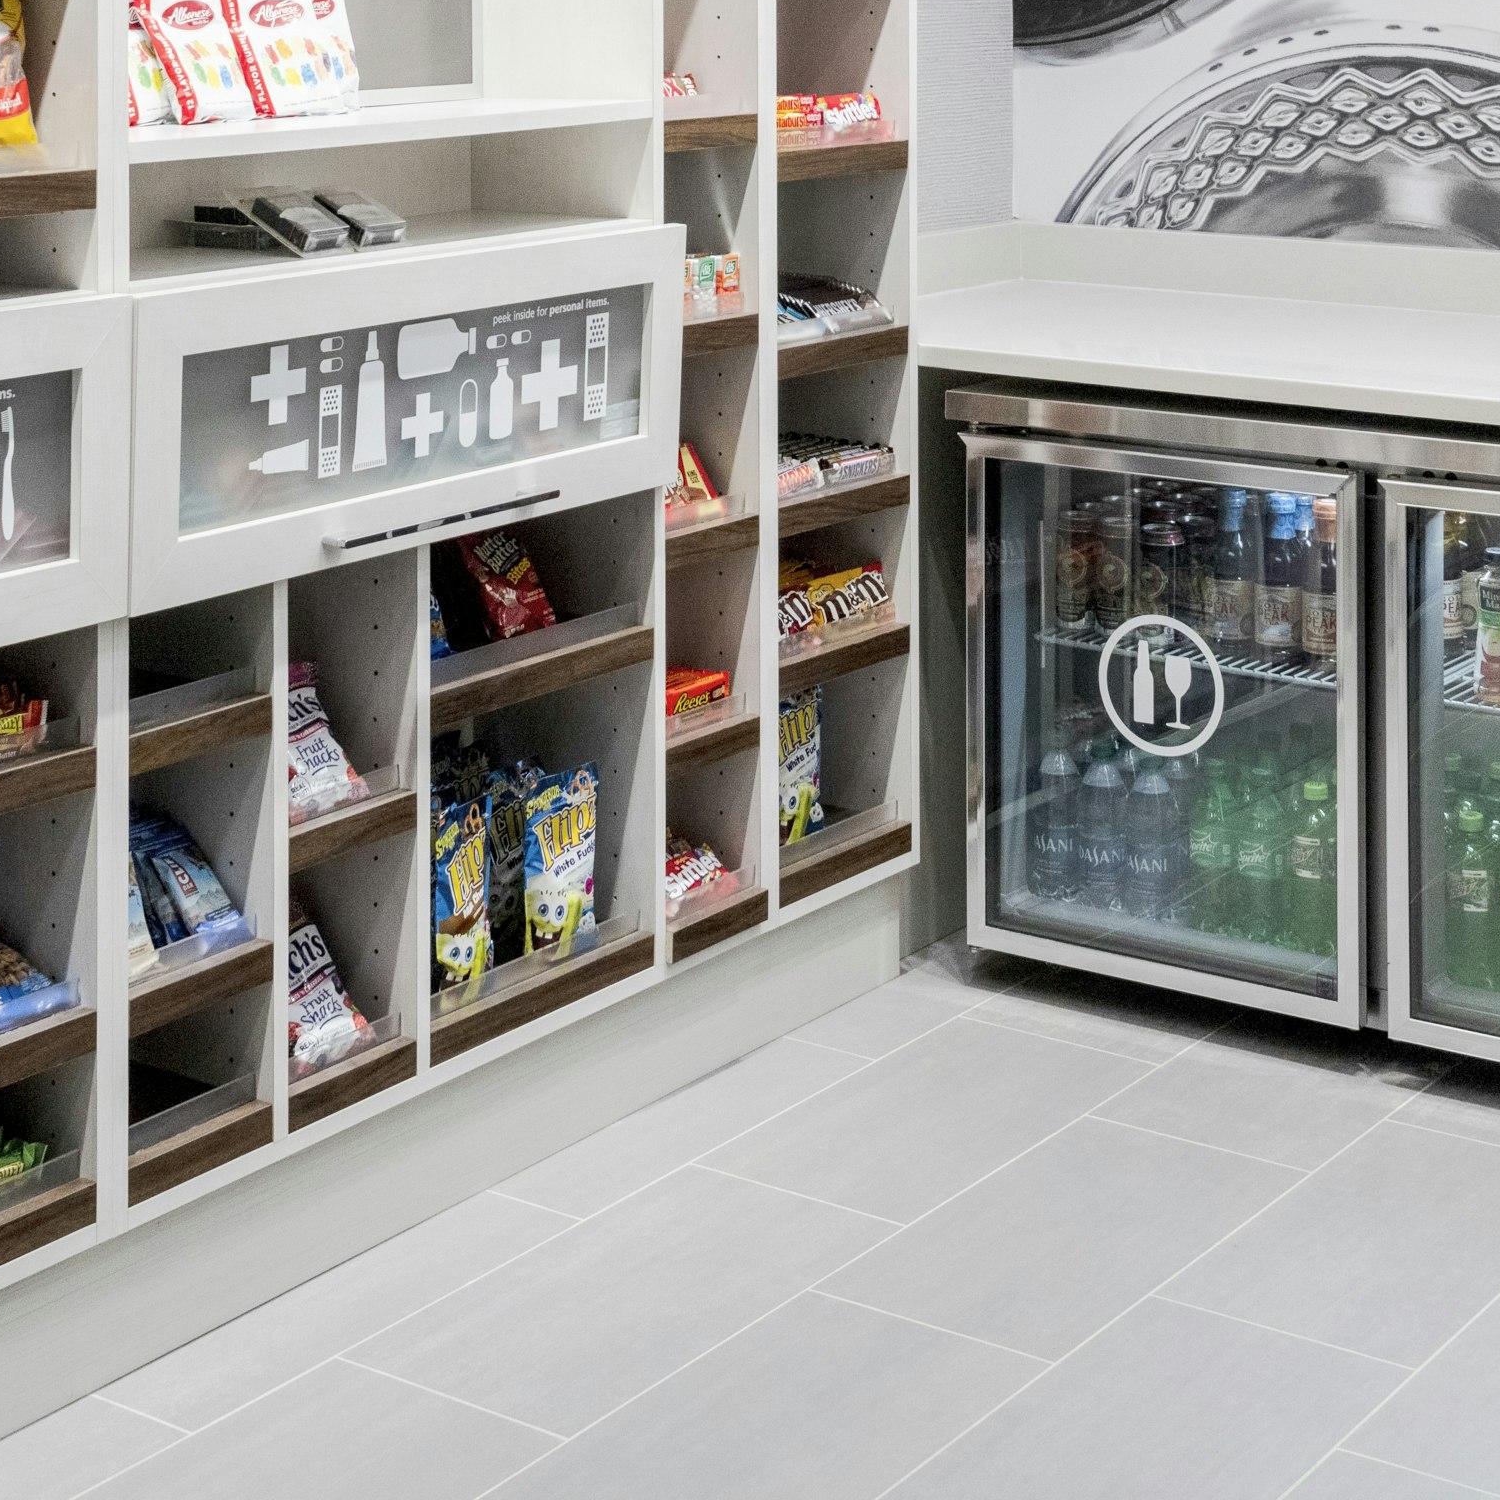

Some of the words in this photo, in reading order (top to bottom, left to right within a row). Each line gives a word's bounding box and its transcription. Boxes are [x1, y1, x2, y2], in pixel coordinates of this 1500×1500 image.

[168, 7, 213, 26] Albanese
[249, 65, 268, 103] FLAVOR
[825, 100, 880, 131] Skittles
[493, 312, 511, 327] peek
[513, 308, 535, 320] inside
[537, 306, 548, 317] for
[549, 299, 584, 317] personal
[585, 297, 610, 309] items.
[841, 457, 879, 480] SNICKERS
[473, 532, 507, 563] Nutter
[487, 538, 519, 574] Butter
[506, 557, 531, 585] Bites
[1258, 609, 1290, 622] PEAK
[674, 691, 710, 715] Reese's
[295, 748, 340, 776] Snacks
[296, 737, 329, 760] Fruit
[786, 754, 805, 773] White
[554, 858, 575, 878] White
[1238, 850, 1269, 865] Sprite
[666, 852, 723, 899] Skittles
[300, 988, 334, 1016] Fruit
[300, 1000, 343, 1031] Snacks
